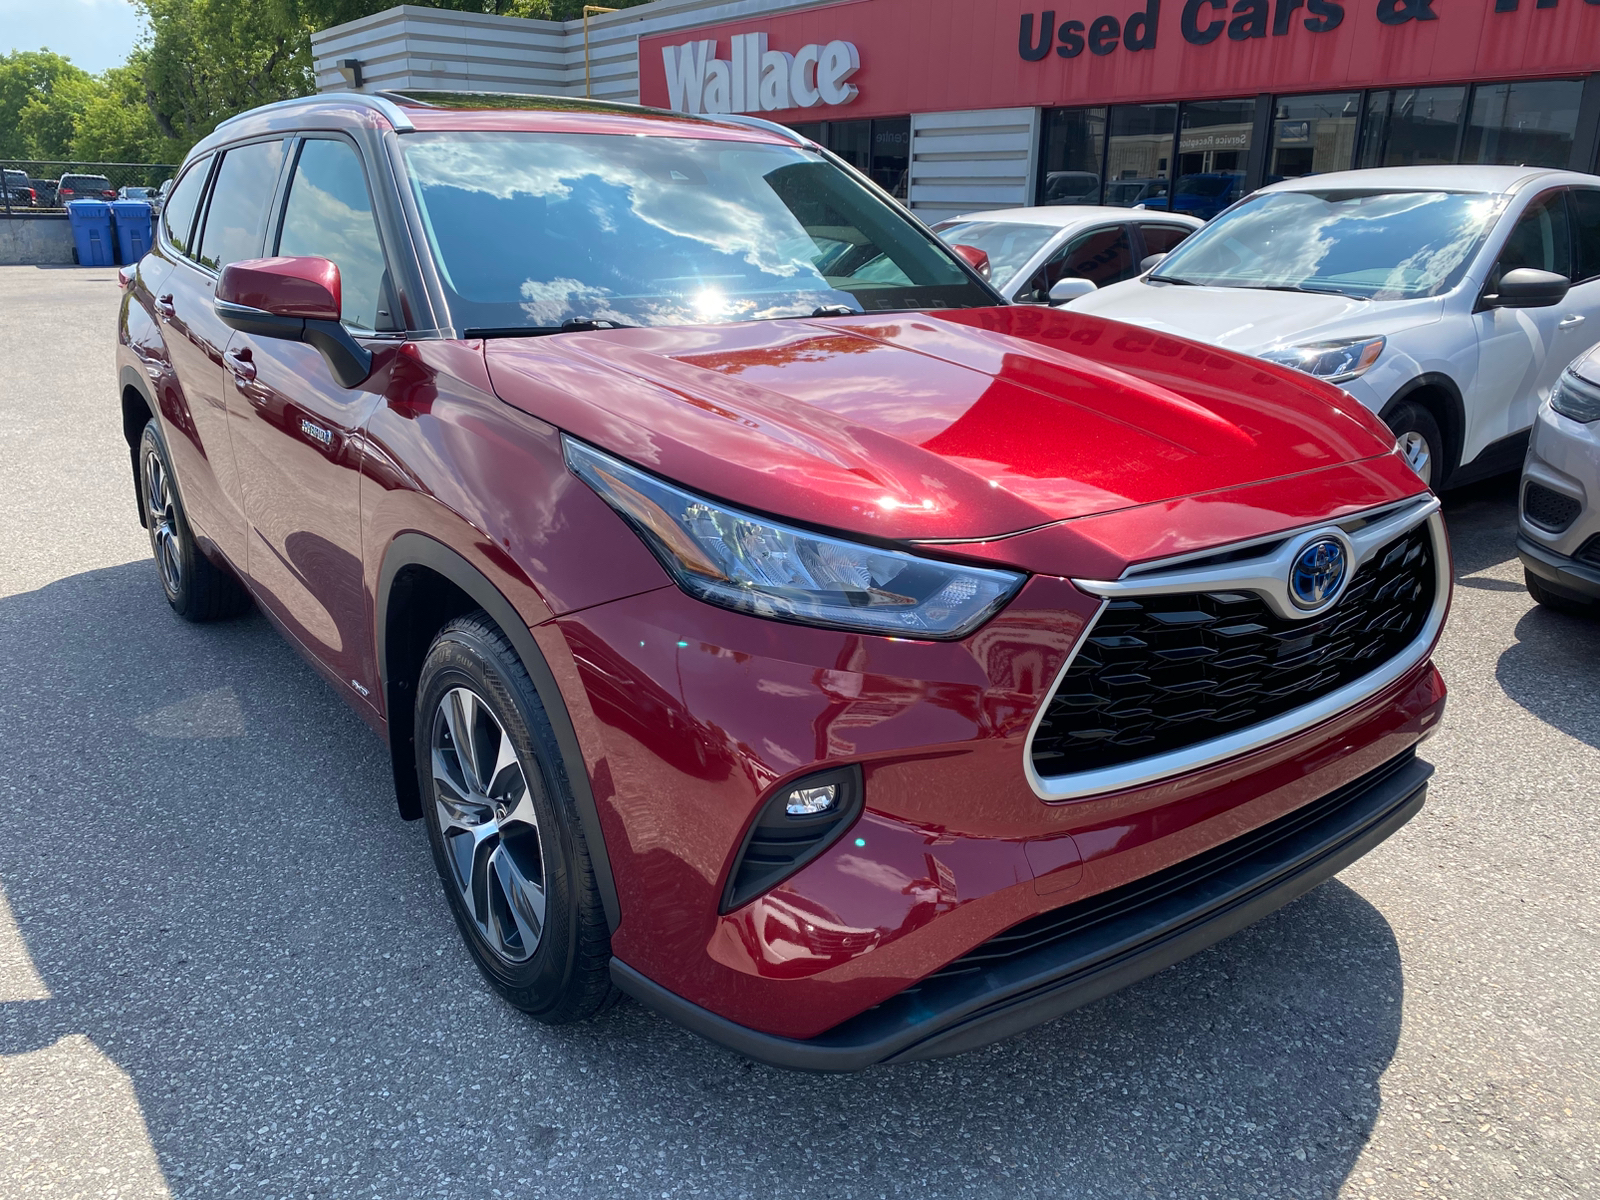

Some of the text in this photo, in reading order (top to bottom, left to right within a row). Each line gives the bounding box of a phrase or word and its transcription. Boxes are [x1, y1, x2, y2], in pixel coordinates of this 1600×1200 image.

[1018, 10, 1158, 62] Used
[1180, 0, 1345, 46] Cars
[662, 32, 860, 114] Wallace
